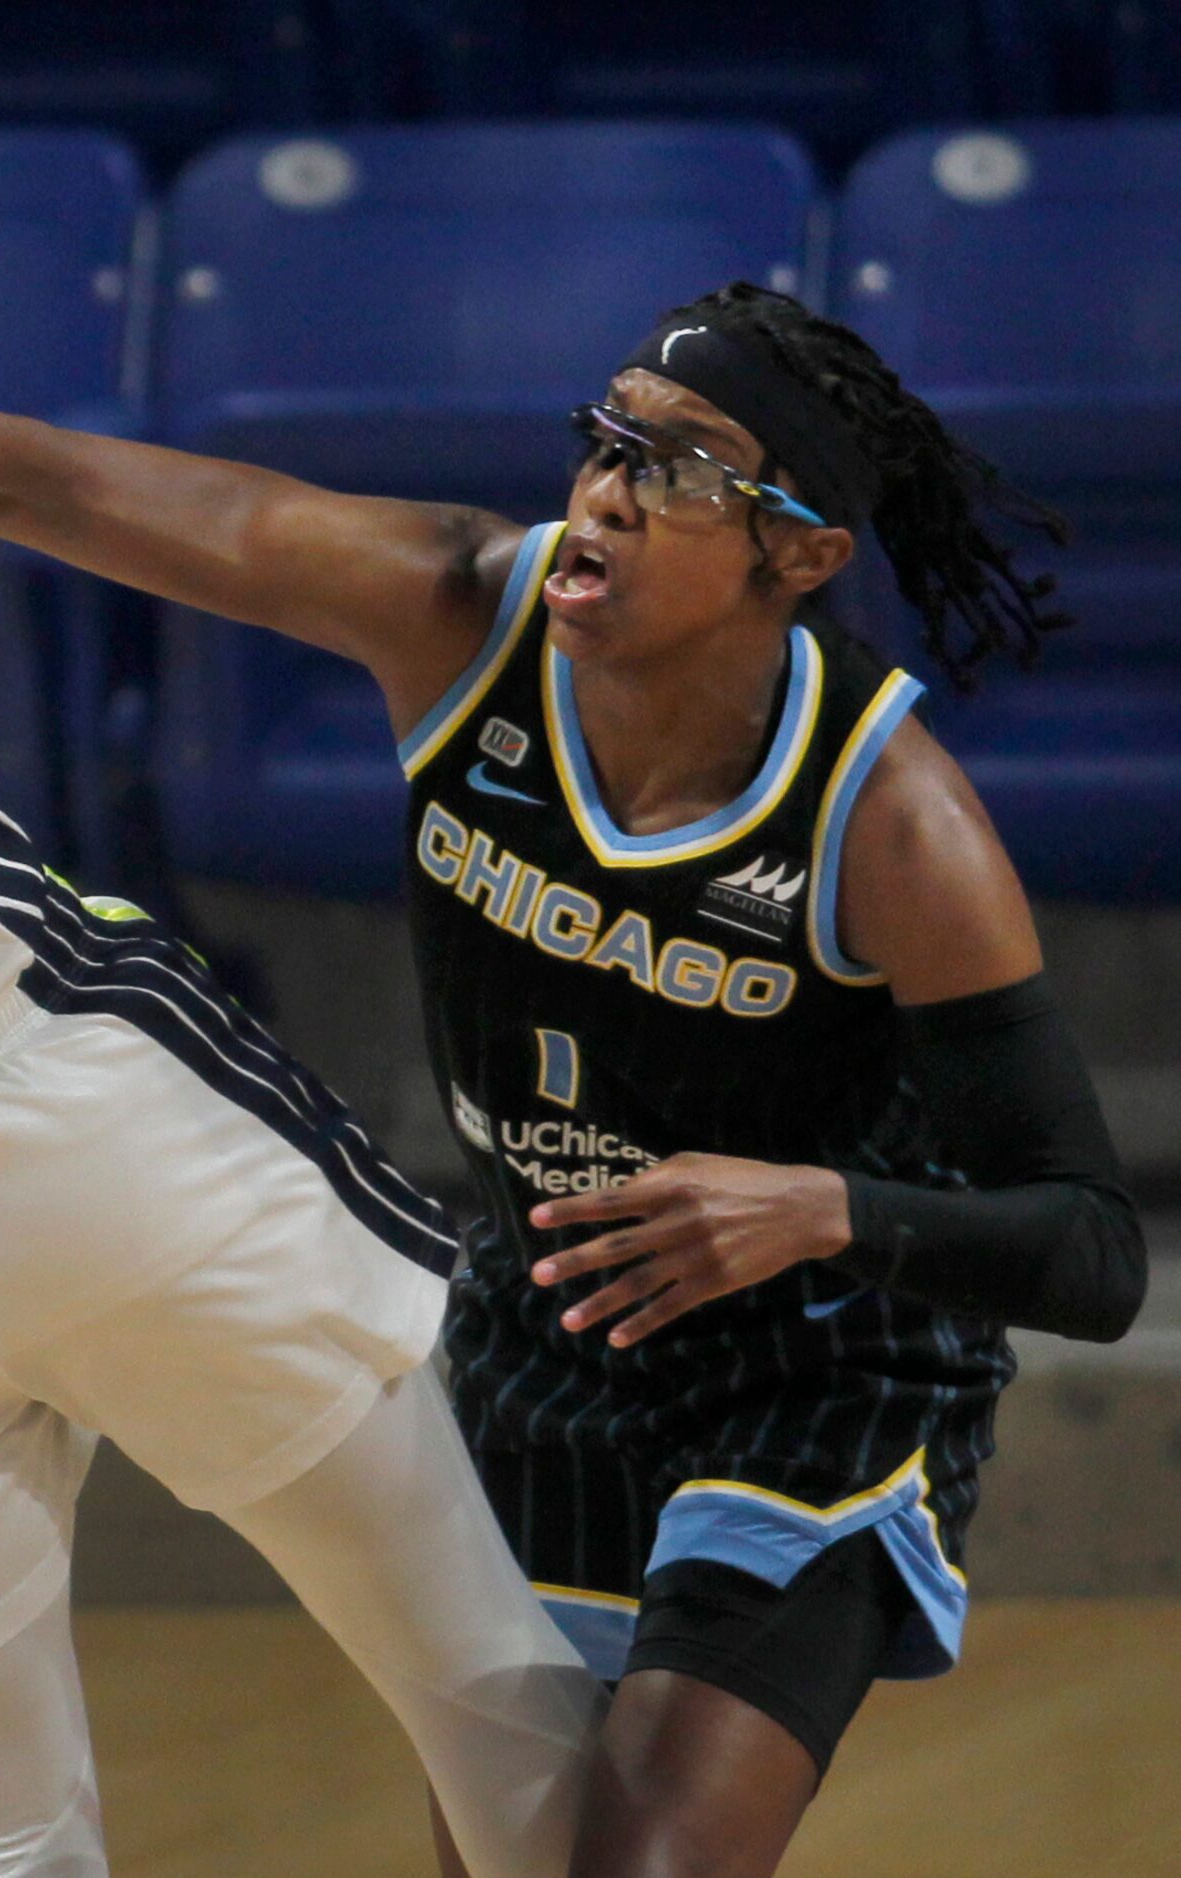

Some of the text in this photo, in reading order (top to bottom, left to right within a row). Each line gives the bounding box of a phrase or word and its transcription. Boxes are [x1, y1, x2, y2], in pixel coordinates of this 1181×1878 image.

[417, 800, 797, 1018] CHICAGO
[534, 1028, 580, 1110] 1
[501, 1120, 660, 1163] UChica
[504, 1153, 645, 1195] Medic
